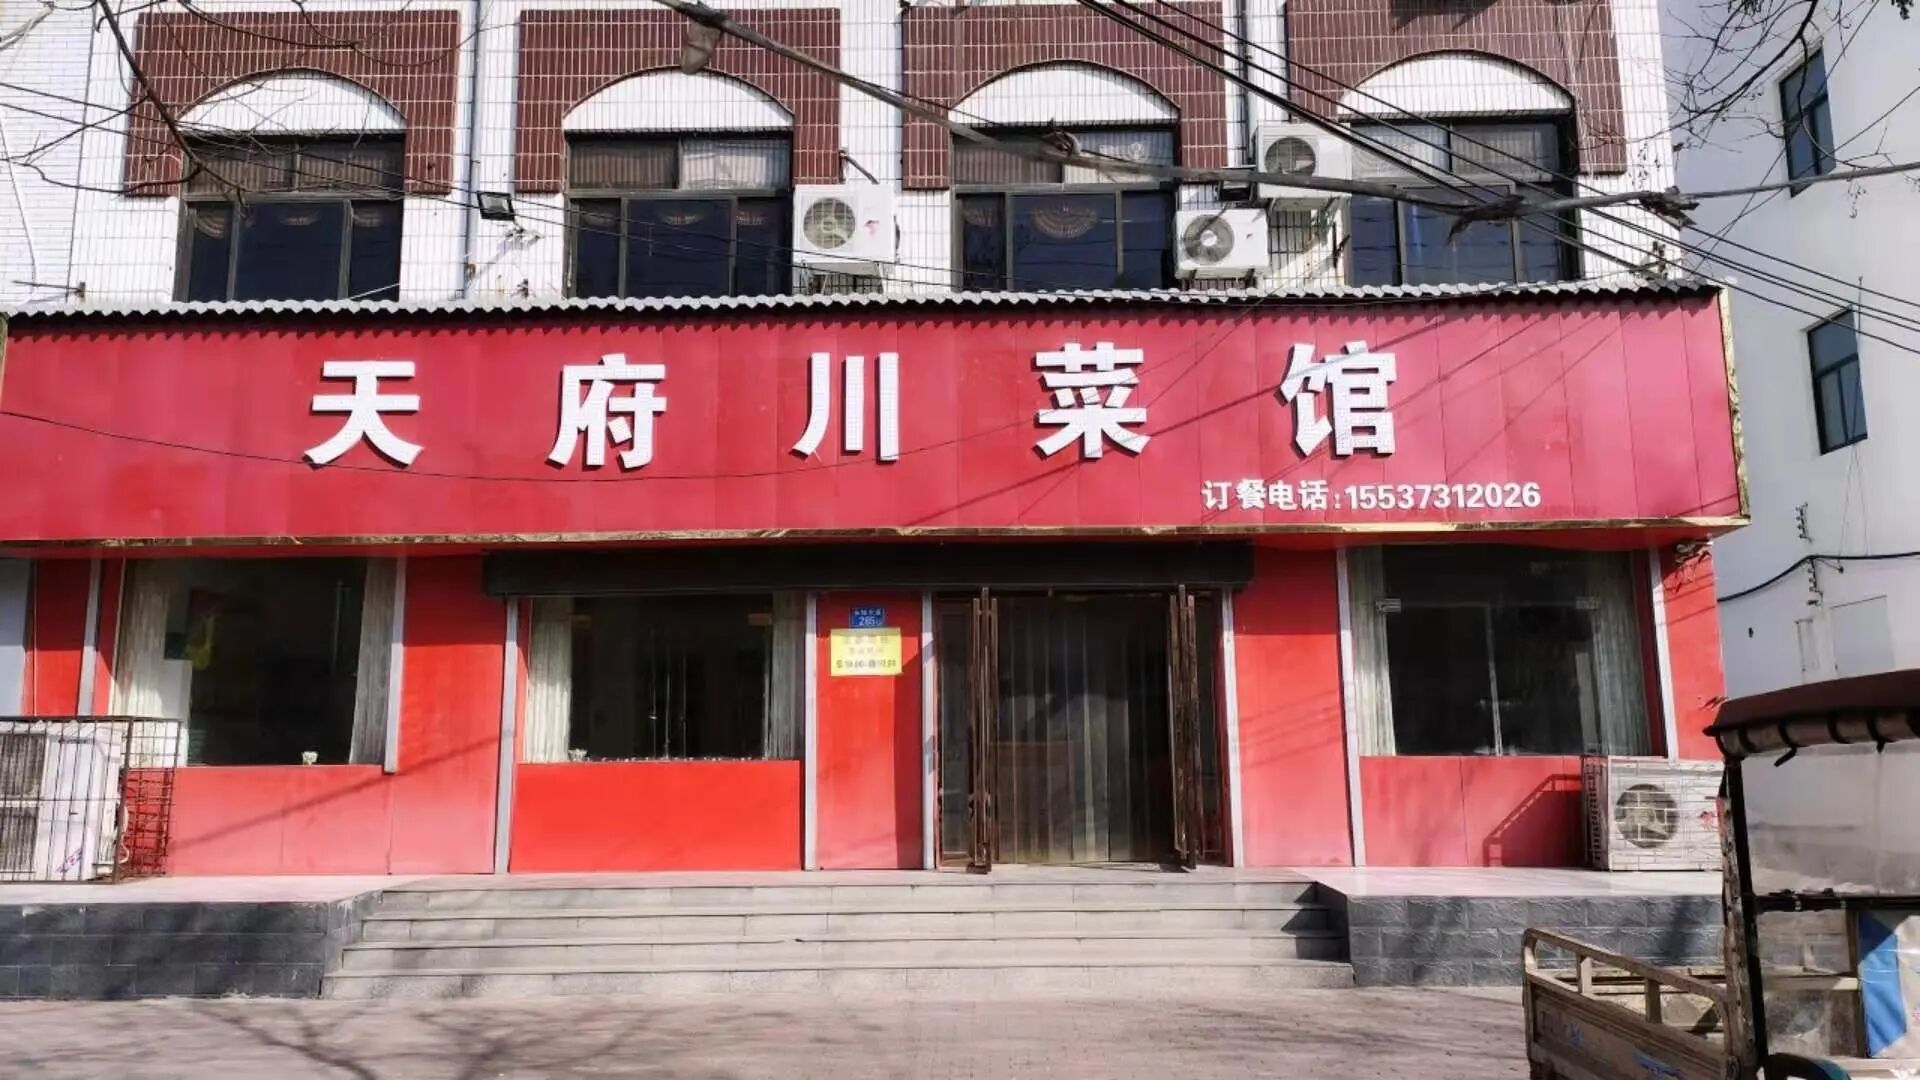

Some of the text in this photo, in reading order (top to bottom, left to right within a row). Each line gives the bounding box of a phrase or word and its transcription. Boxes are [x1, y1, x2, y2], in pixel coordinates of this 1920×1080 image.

[304, 340, 1398, 469] 天府川菜馆
